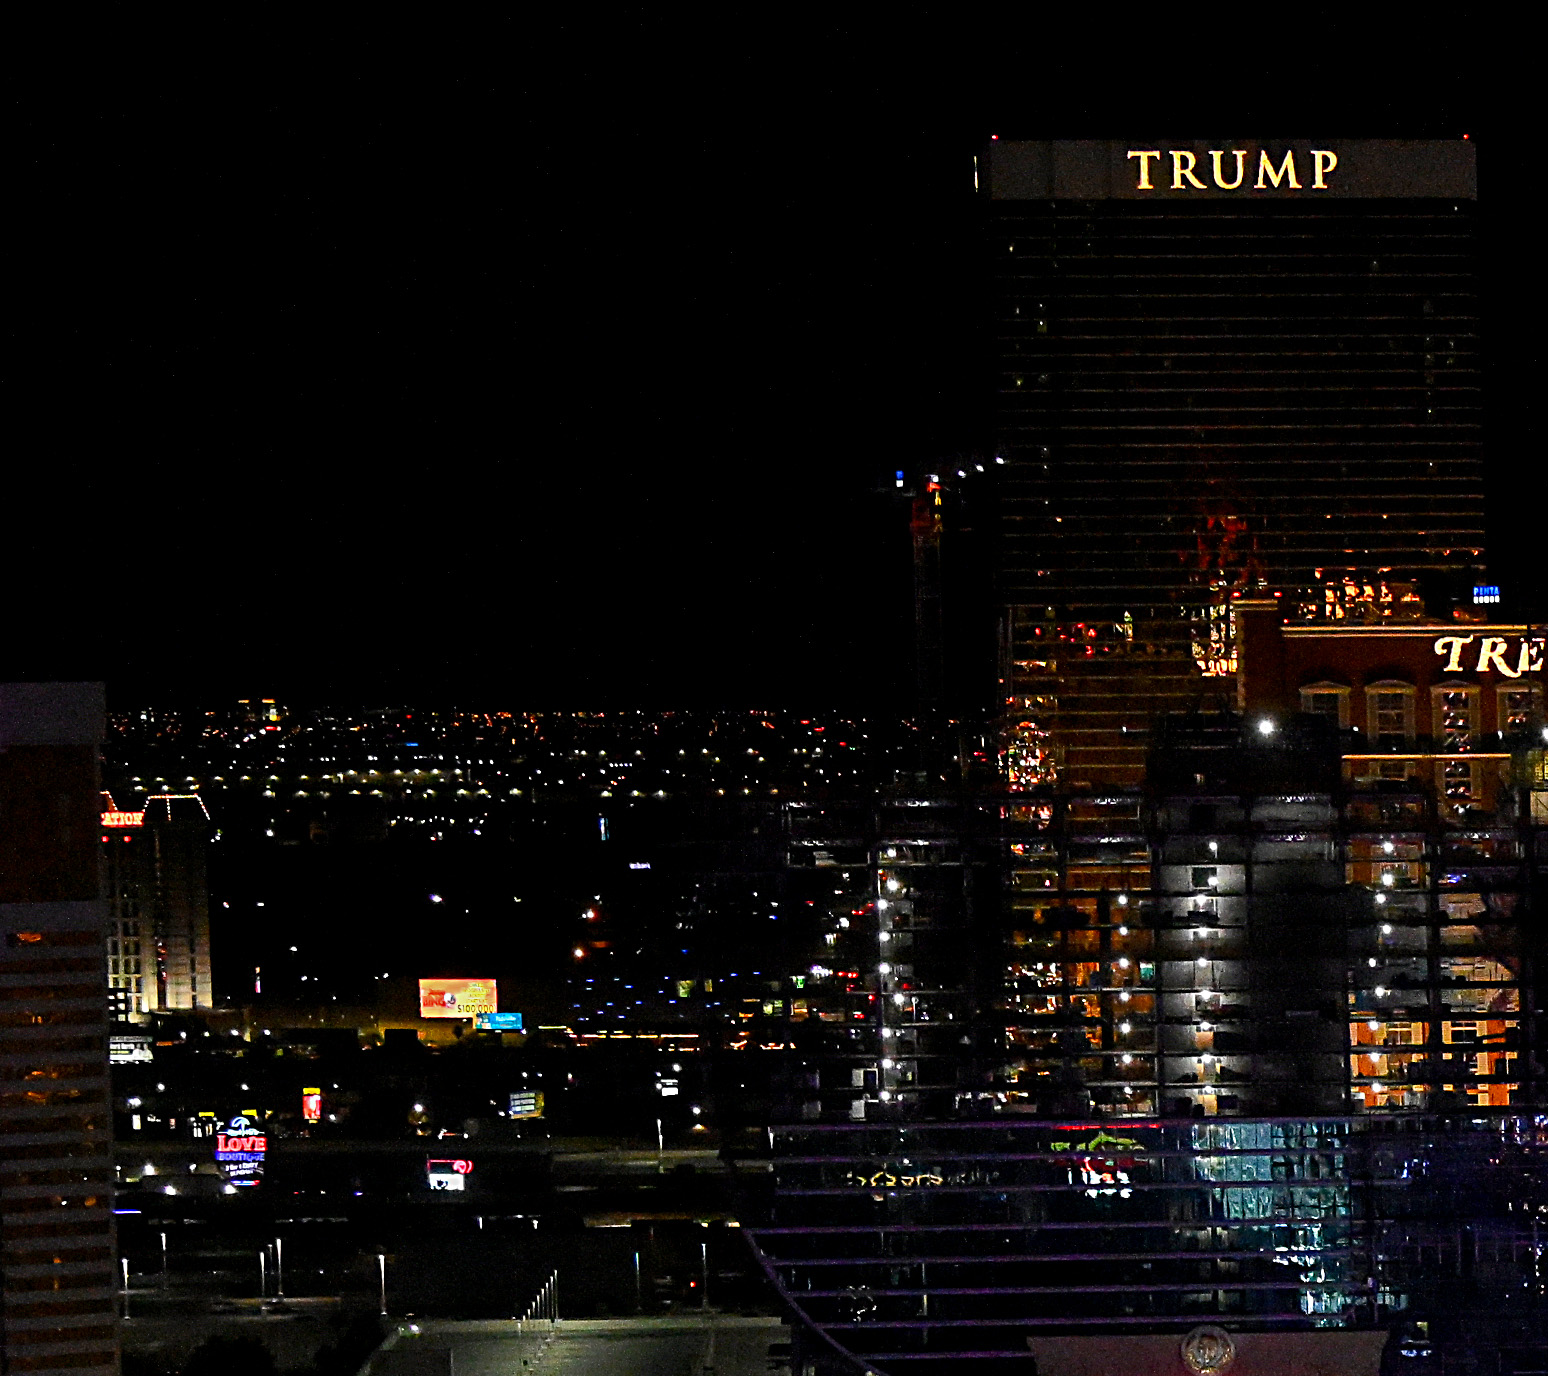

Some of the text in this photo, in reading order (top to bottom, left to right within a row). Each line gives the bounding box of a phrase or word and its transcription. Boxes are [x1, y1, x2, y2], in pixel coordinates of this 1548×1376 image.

[1127, 150, 1338, 190] TRUMP
[101, 812, 144, 827] ATION
[217, 1135, 267, 1153] LOVE
[218, 1152, 266, 1163] BOUTIQUE
